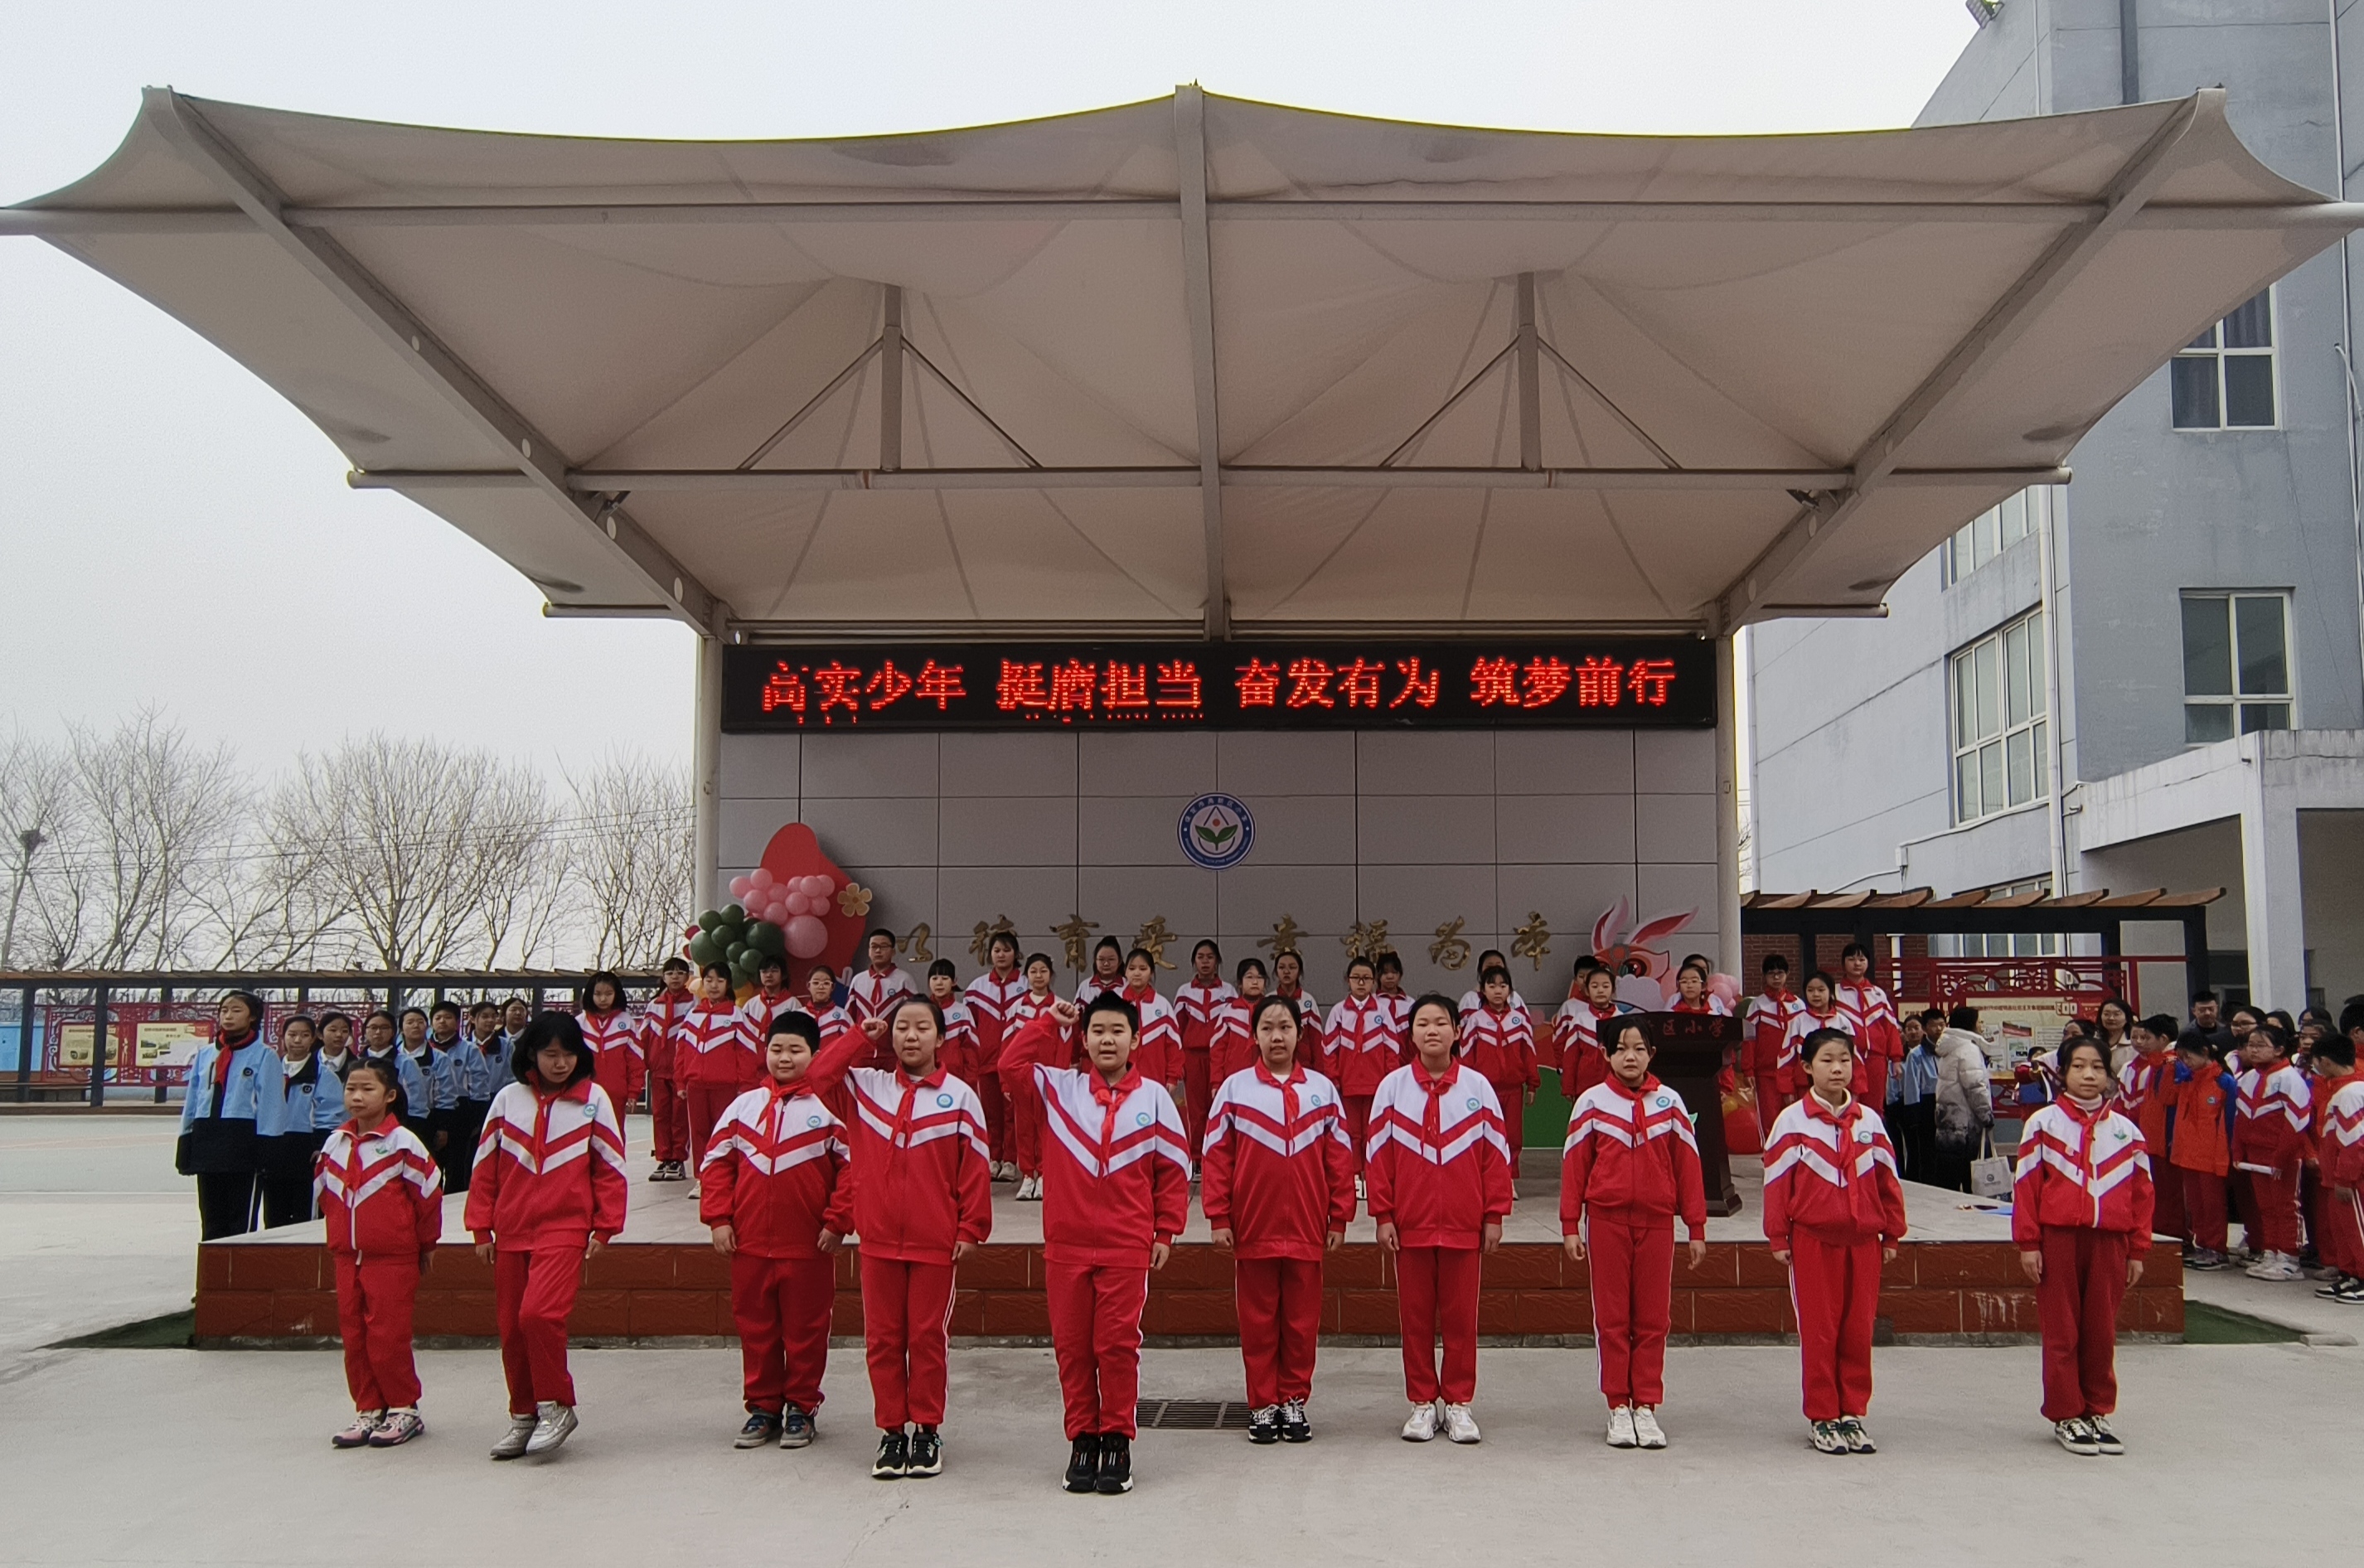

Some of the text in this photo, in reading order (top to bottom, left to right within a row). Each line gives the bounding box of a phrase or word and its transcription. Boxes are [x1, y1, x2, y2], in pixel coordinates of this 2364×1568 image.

[995, 659, 1203, 724] 挺膺担当
[1234, 657, 1440, 709] 奋发有为
[1470, 656, 1676, 709] 筑梦前行
